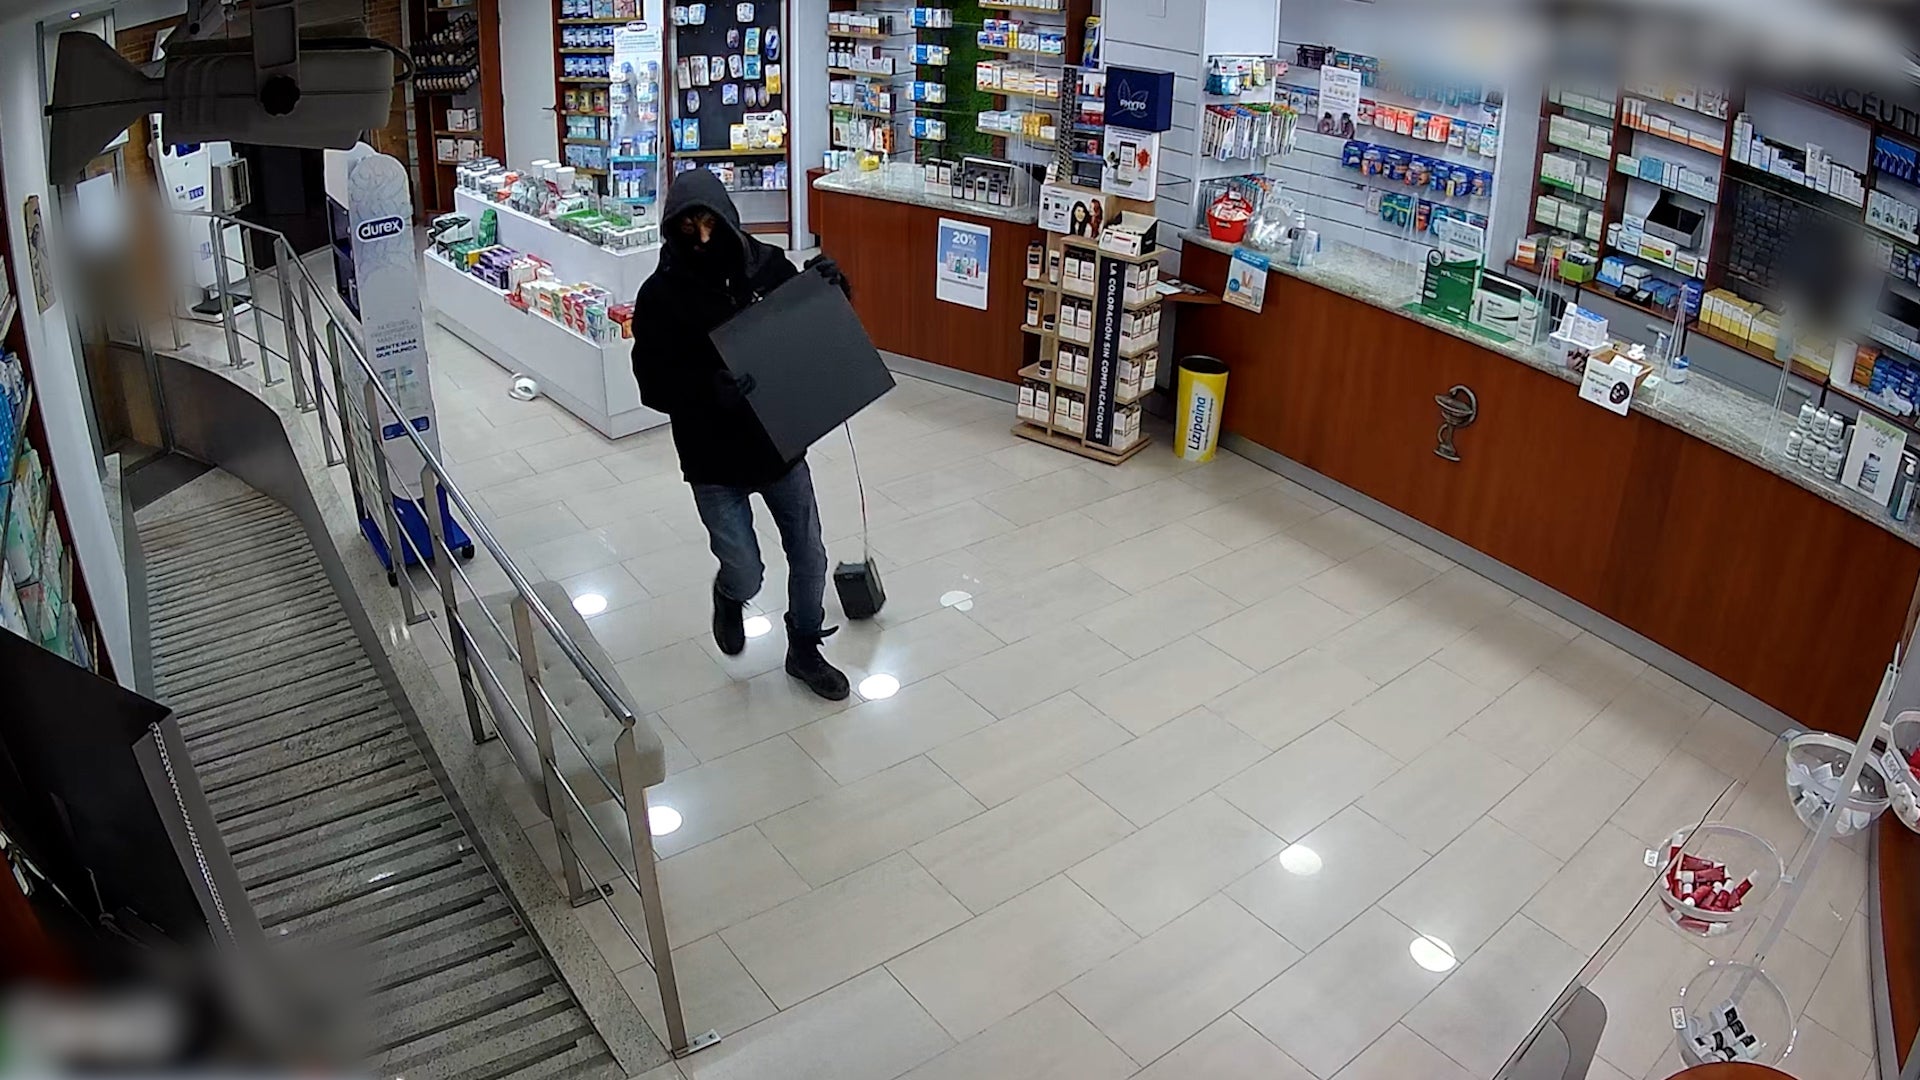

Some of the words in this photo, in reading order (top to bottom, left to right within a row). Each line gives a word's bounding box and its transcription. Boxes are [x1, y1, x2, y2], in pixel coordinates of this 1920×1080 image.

[1119, 98, 1147, 111] PHYTO
[360, 219, 402, 238] durex
[951, 230, 977, 247] 20%
[1109, 262, 1118, 276] LA
[1104, 278, 1117, 341] COLORACIÓN
[1102, 341, 1112, 359] SIN
[1095, 359, 1110, 439] COMPLICACIONES
[1187, 396, 1207, 450] Lizipaina
